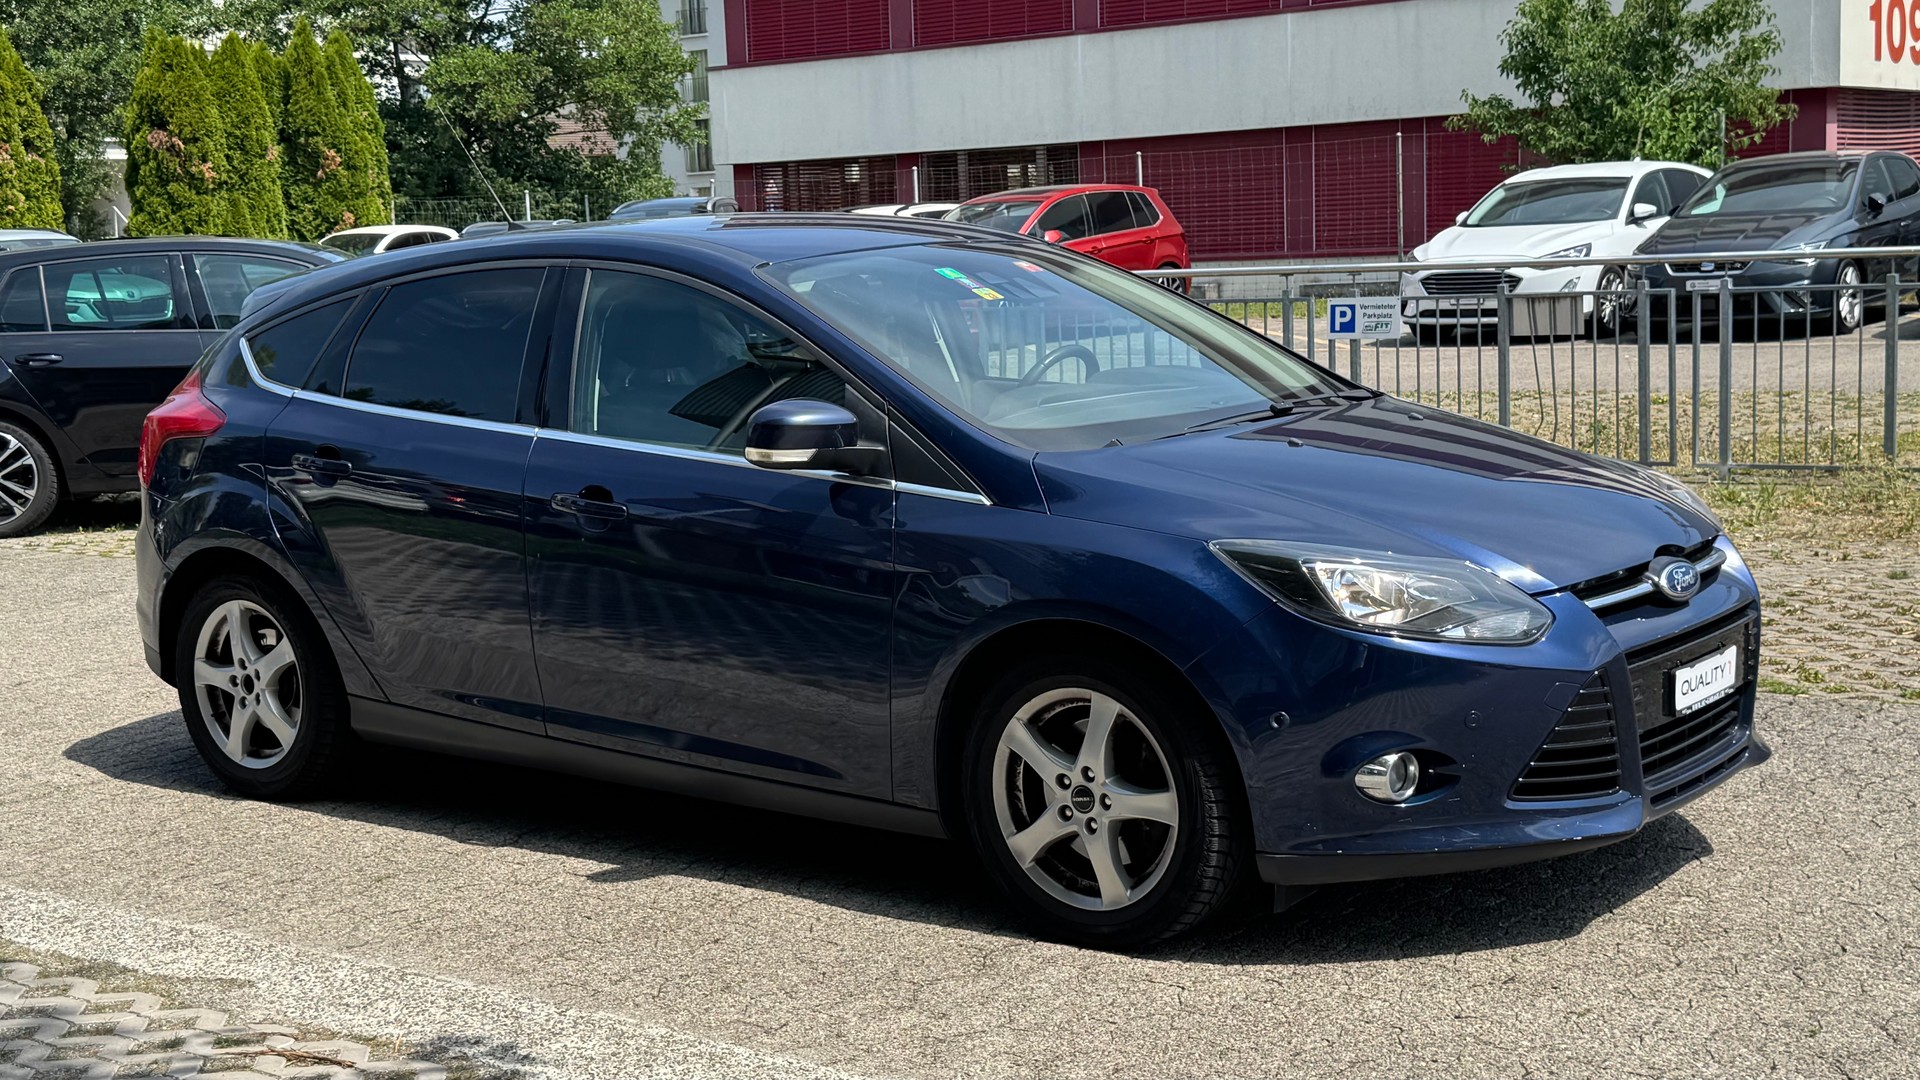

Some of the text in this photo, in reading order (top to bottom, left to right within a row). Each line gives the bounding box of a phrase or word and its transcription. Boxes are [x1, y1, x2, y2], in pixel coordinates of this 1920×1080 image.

[1335, 306, 1352, 331] P
[1362, 312, 1393, 320] Parkplatz
[1374, 322, 1390, 331] FIT
[1672, 567, 1696, 591] Ford
[1681, 662, 1727, 696] QUALITY
